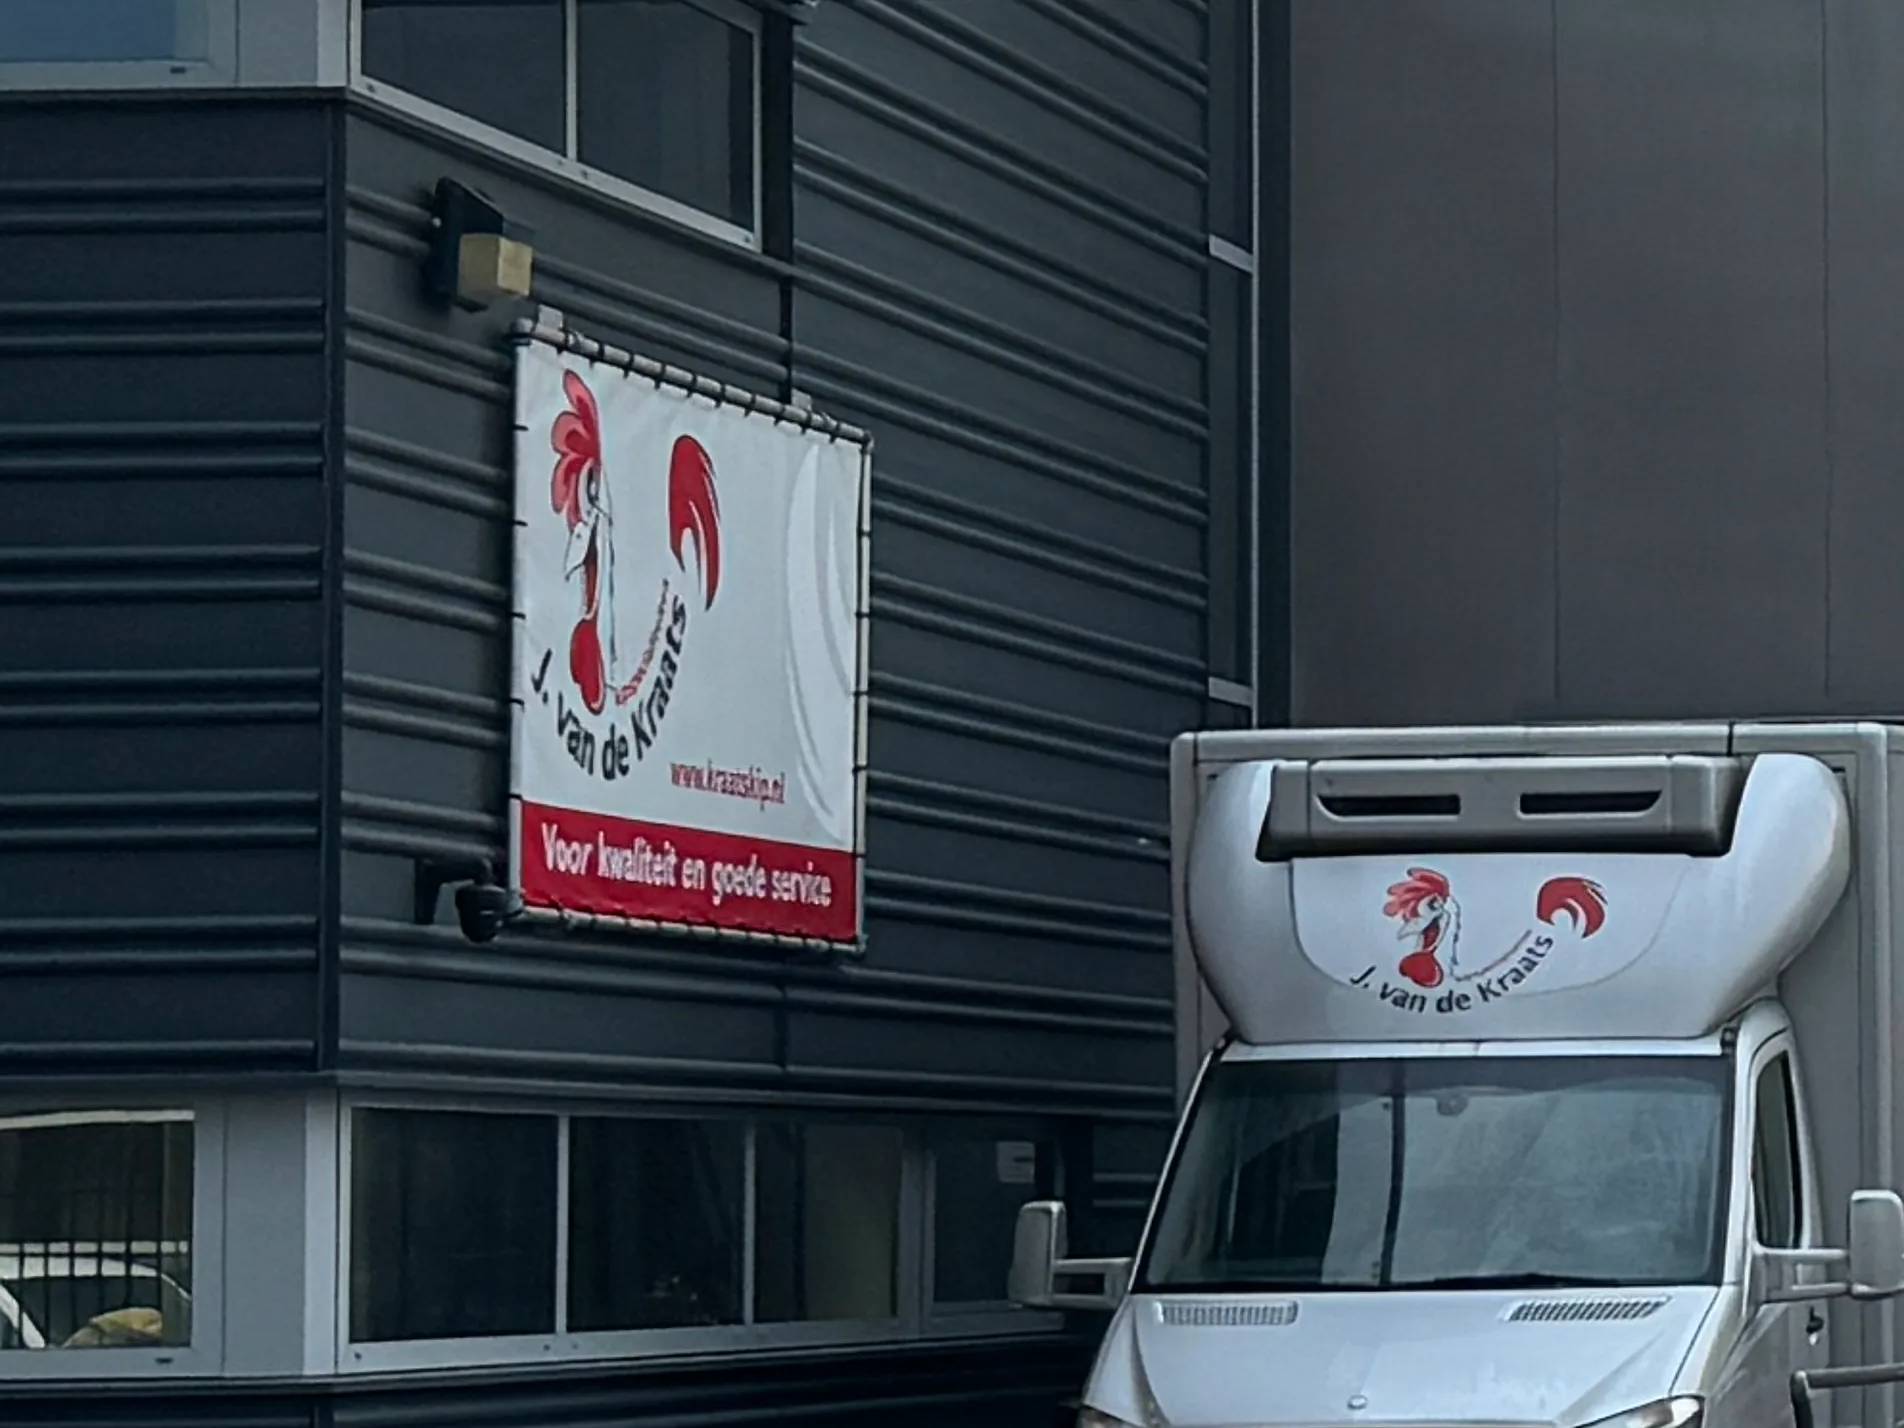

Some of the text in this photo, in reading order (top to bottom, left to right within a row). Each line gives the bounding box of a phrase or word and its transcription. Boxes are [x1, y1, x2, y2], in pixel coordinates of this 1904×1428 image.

[531, 647, 552, 704] J.
[557, 690, 595, 776] van
[602, 722, 630, 781] de
[630, 594, 686, 761] Kraats
[542, 821, 833, 908] Voor kwaliteit en goede service
[1350, 935, 1555, 1014] J. van de Kraats
